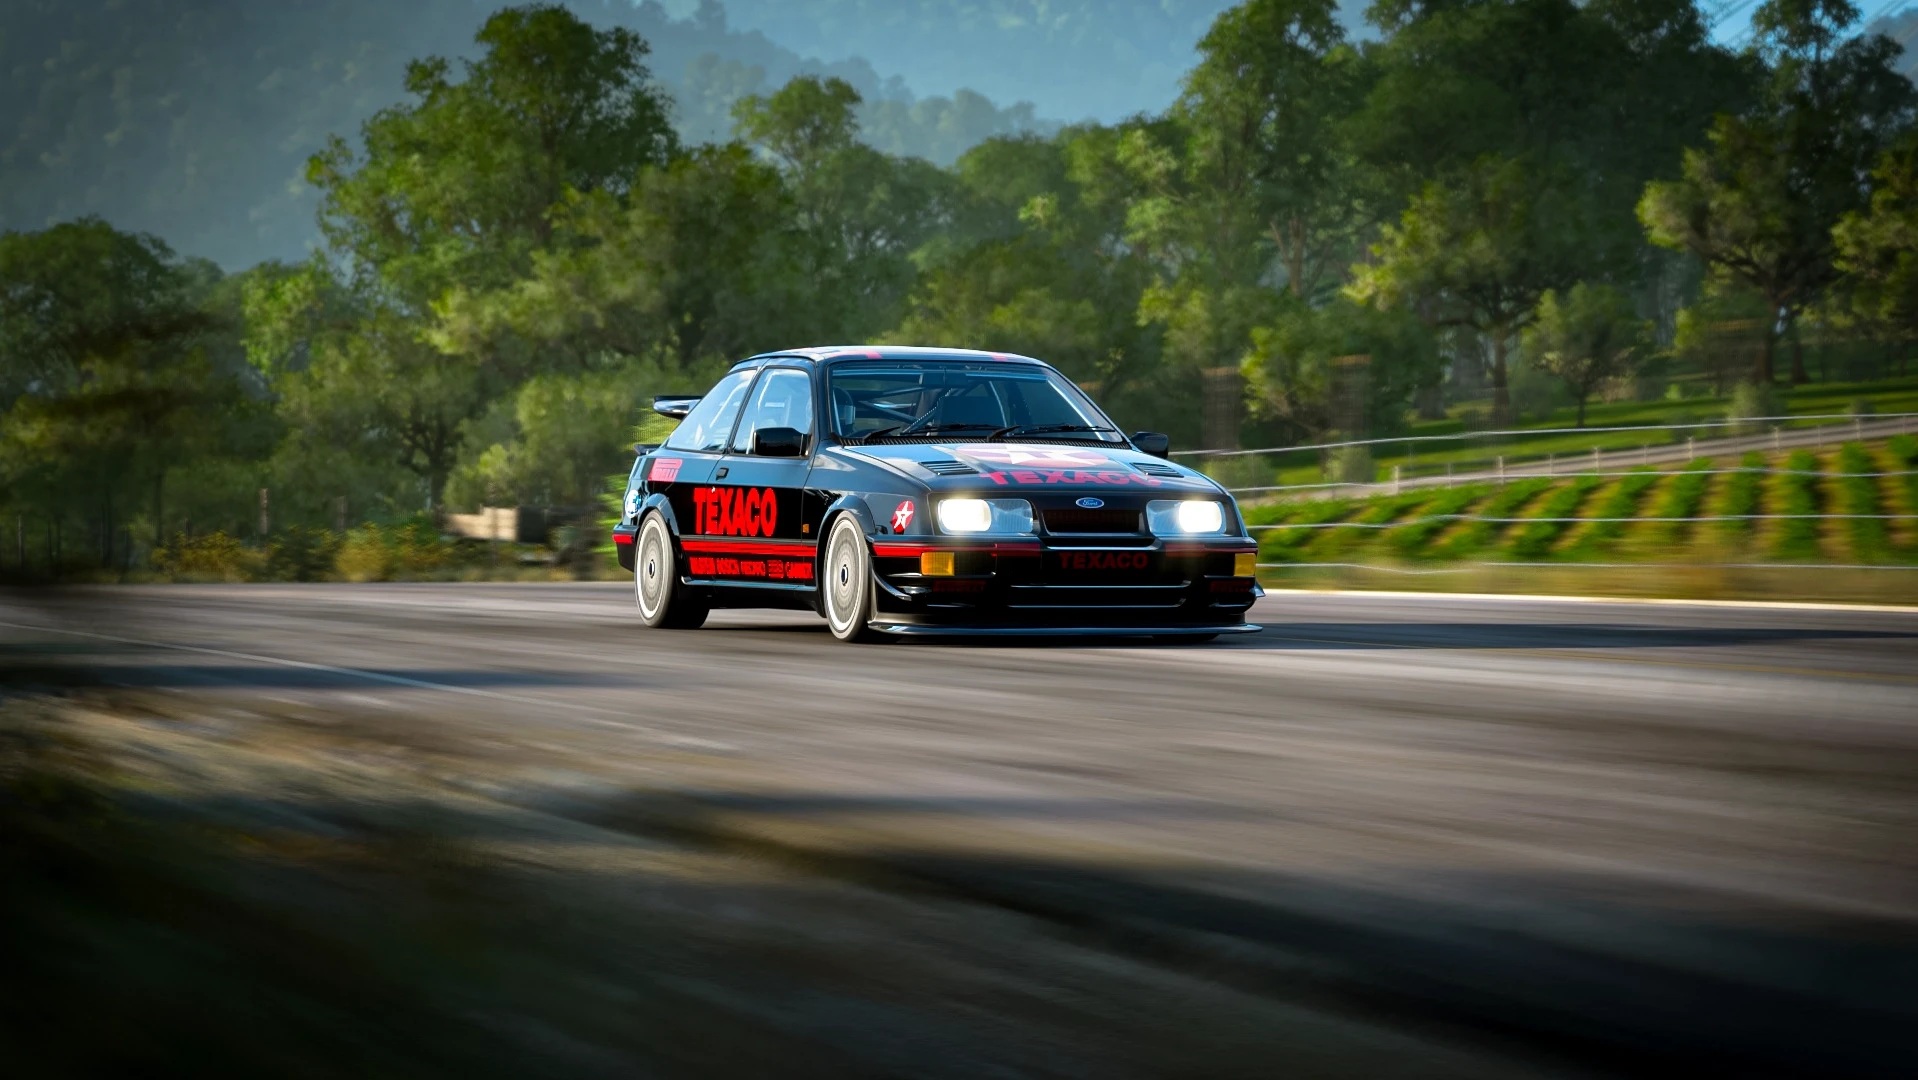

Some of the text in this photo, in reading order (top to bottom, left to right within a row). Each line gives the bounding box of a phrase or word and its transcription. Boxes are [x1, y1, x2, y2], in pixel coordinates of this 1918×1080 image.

[979, 470, 1162, 487] TEXACO
[693, 487, 778, 537] TEXACO
[1058, 551, 1149, 569] TEXACO
